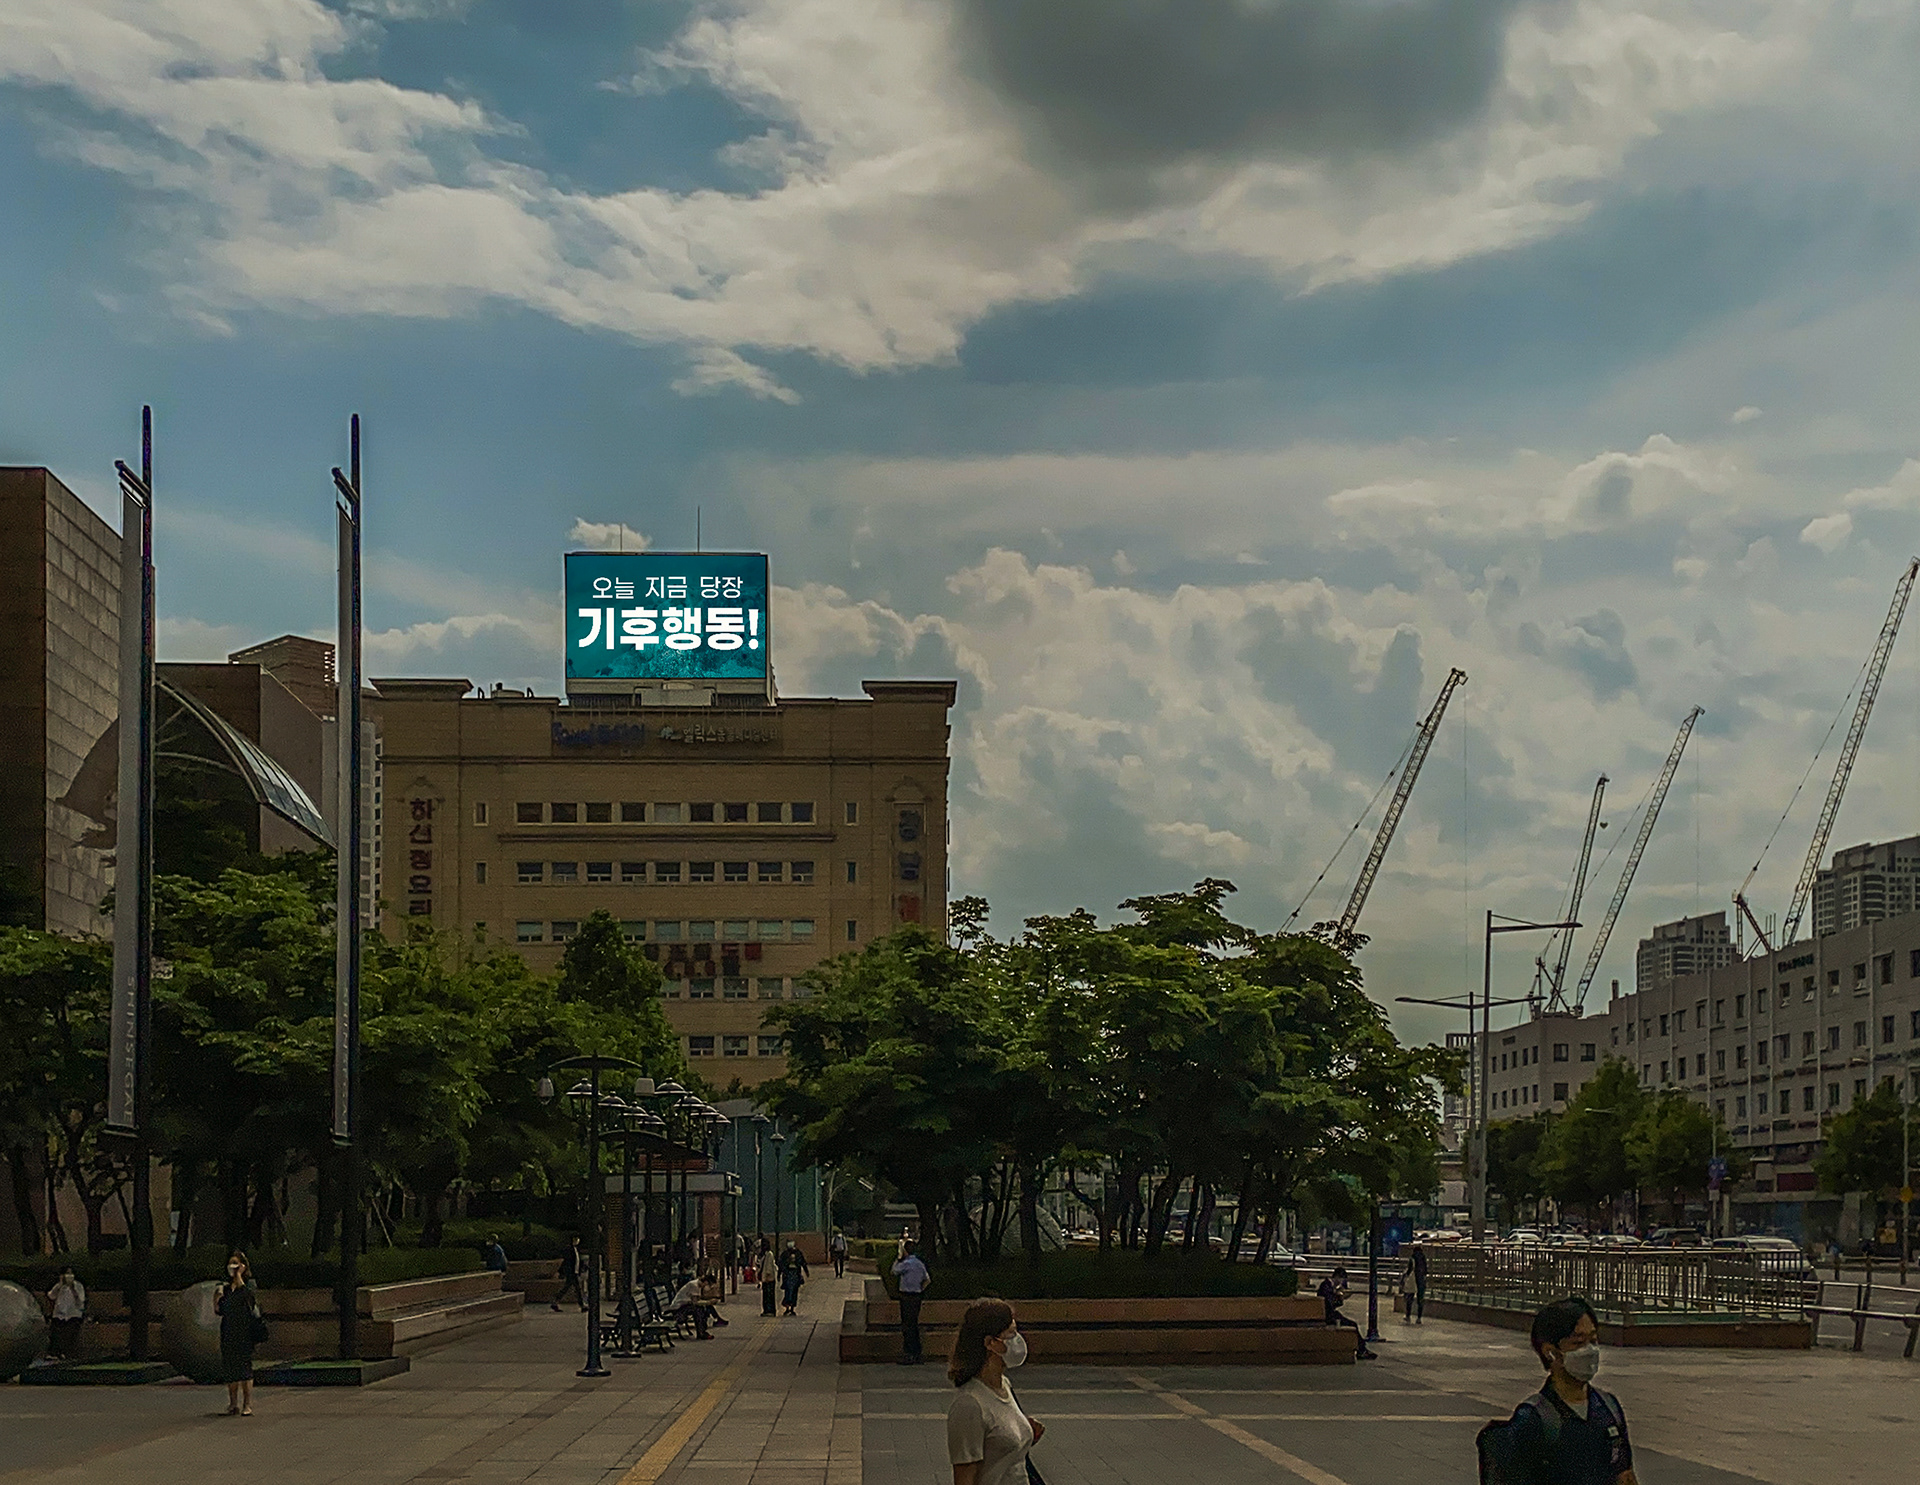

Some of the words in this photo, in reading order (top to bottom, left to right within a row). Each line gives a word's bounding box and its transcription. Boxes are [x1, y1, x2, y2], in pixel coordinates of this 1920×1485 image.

[592, 576, 635, 600] 오늘
[645, 576, 687, 599] 지금
[700, 576, 744, 599] 당장
[578, 606, 760, 651] 기후행동!
[123, 976, 135, 1123] SHINSEGAE
